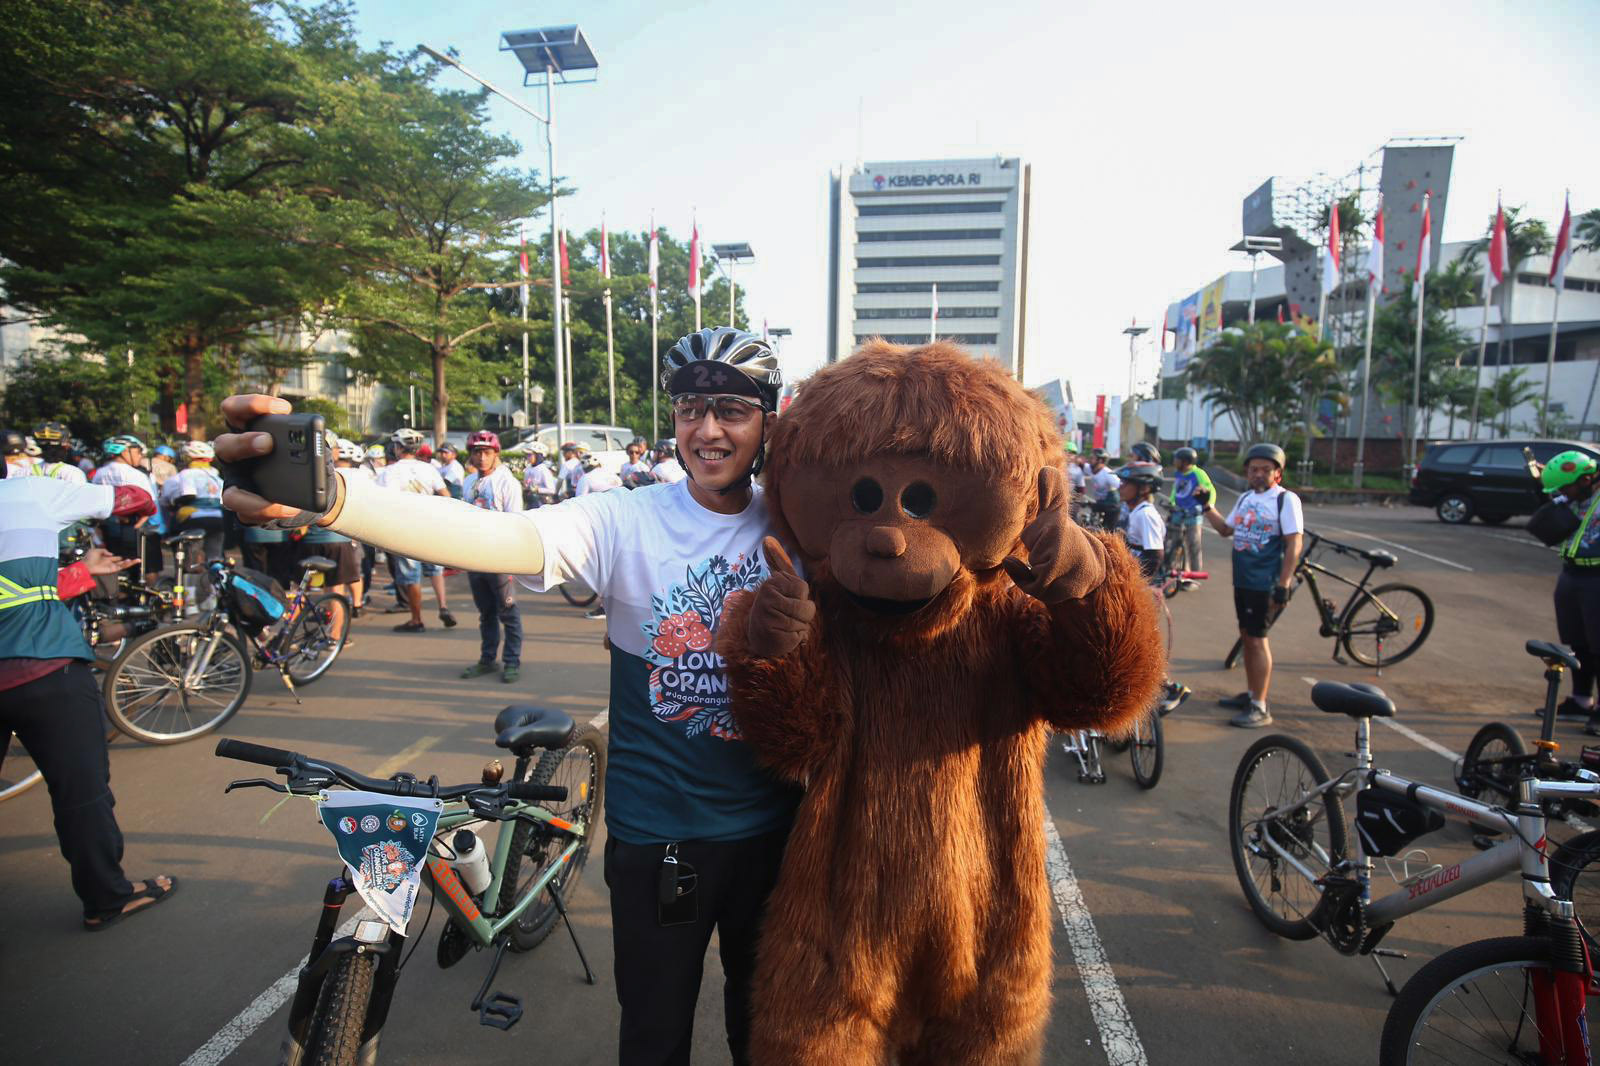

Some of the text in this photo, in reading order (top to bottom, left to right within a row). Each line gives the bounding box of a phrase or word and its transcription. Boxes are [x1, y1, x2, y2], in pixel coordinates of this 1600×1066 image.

[888, 172, 981, 187] KEMENPORA RI
[677, 652, 727, 671] LOVE
[662, 670, 728, 695] ORAN
[1408, 864, 1461, 900] SPECIALIZED
